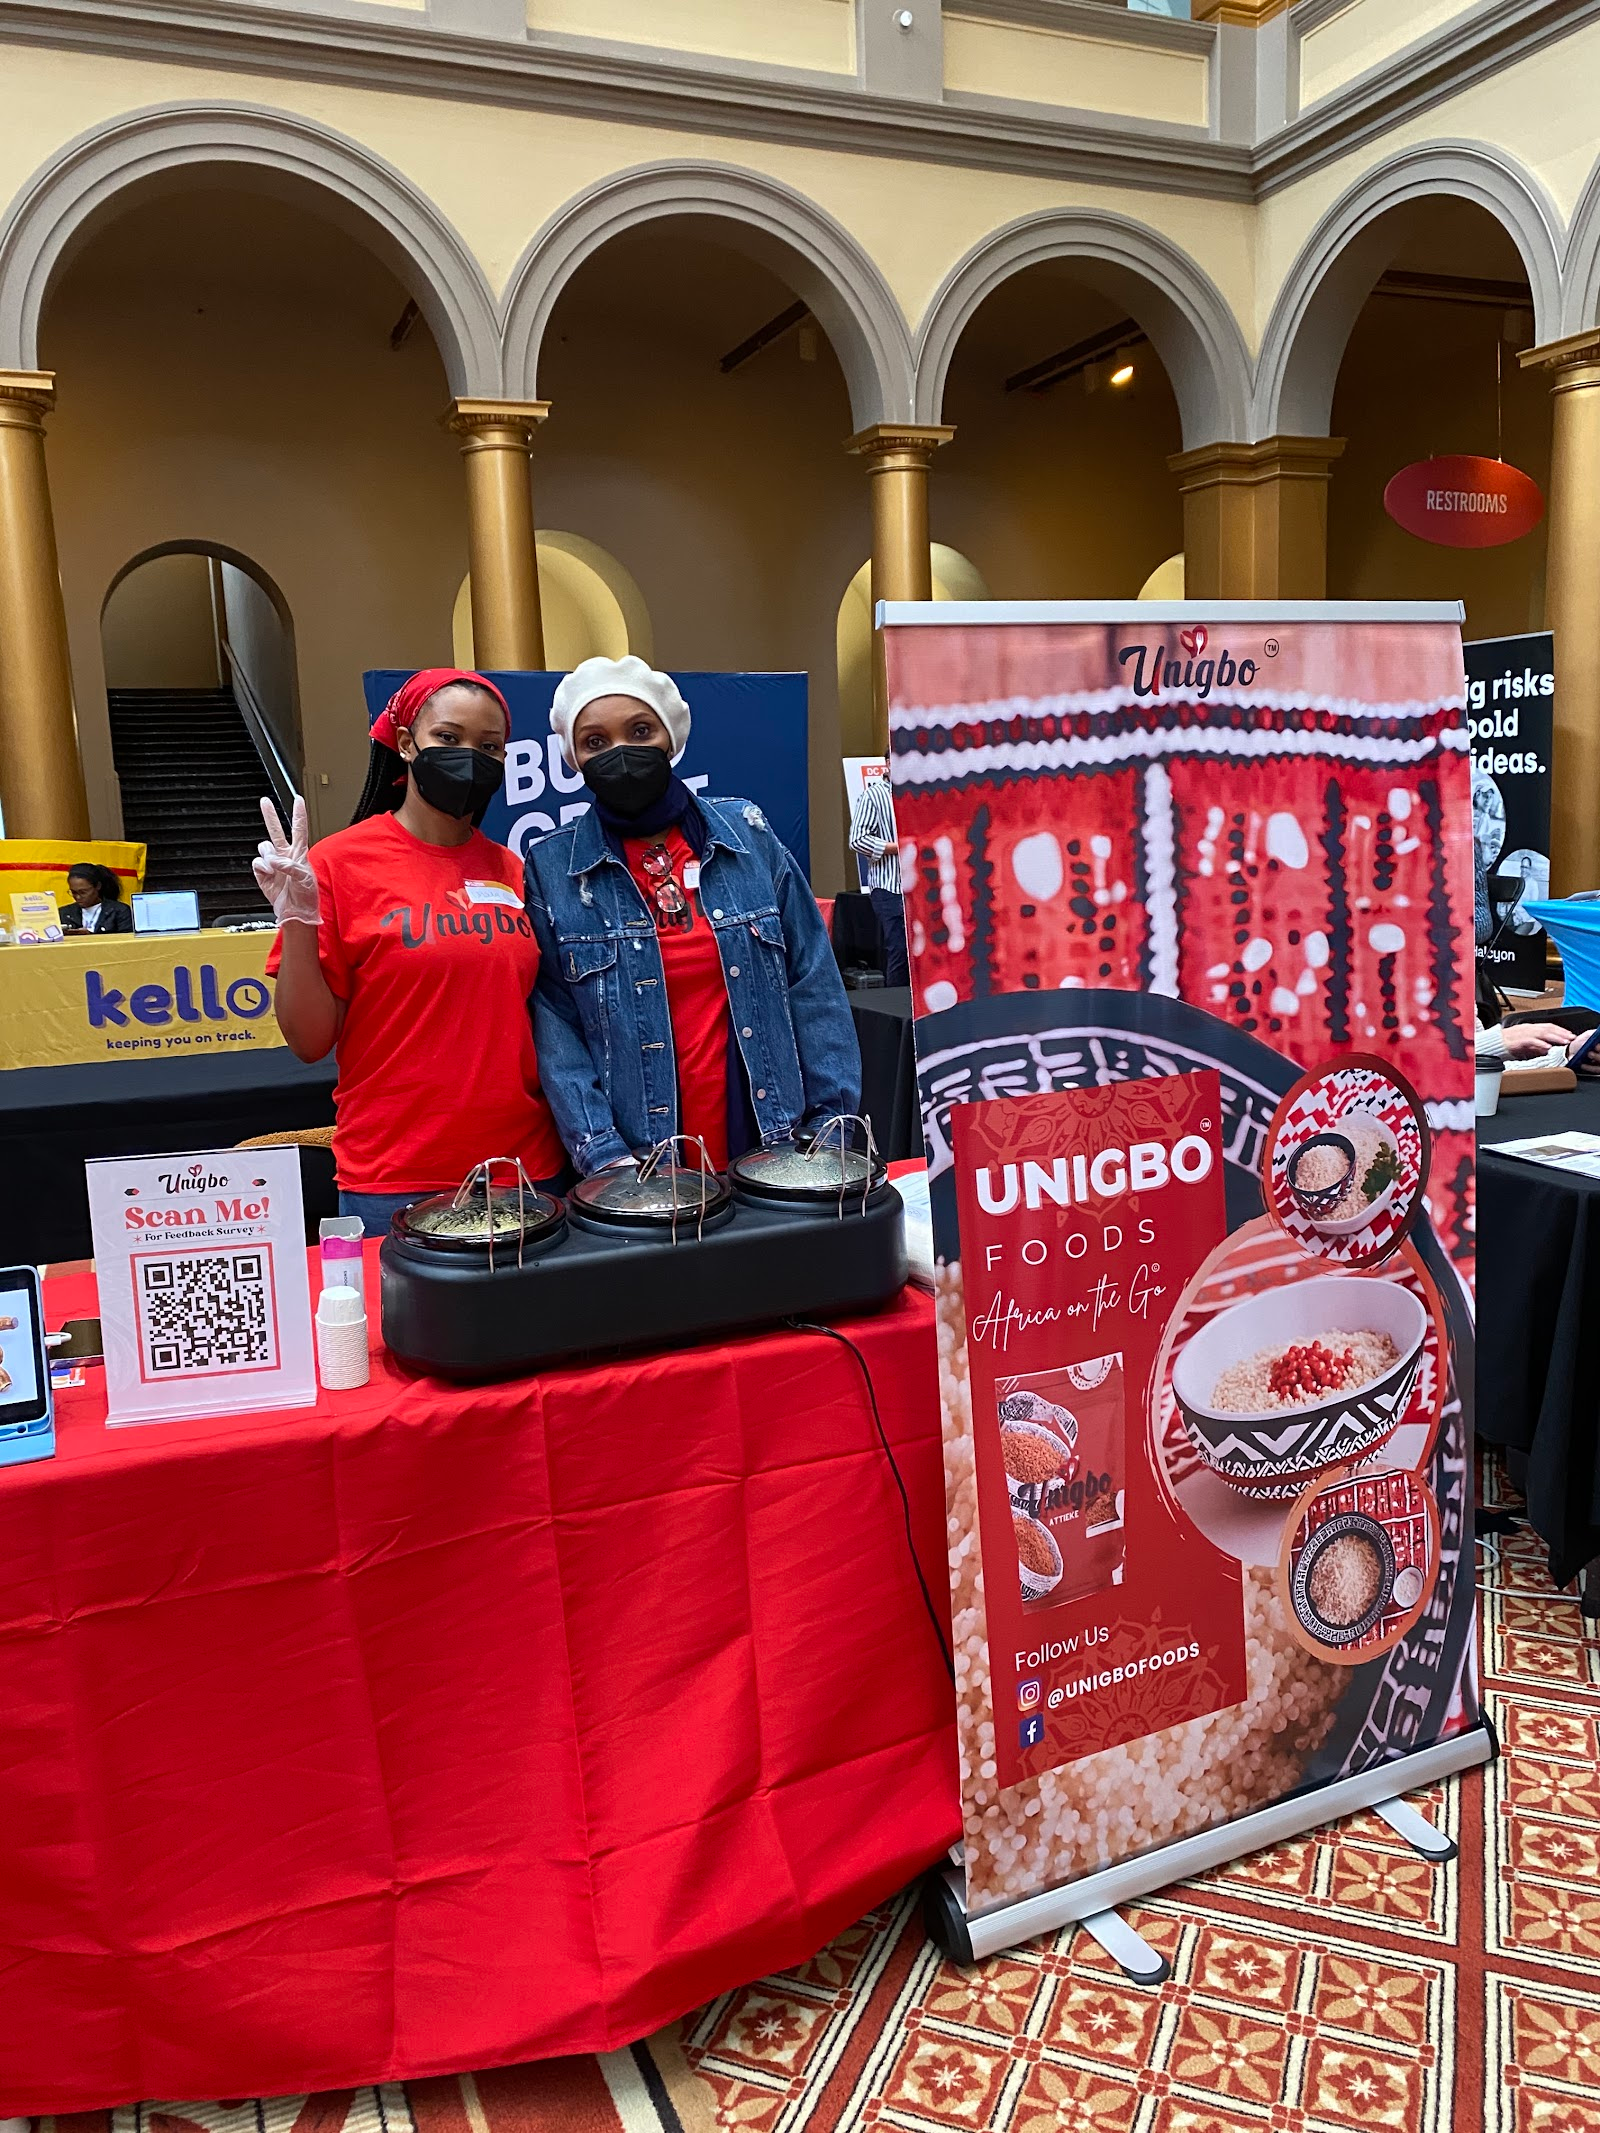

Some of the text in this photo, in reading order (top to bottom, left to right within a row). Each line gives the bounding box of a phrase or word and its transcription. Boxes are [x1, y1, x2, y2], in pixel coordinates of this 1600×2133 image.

[1426, 490, 1508, 513] RESTROOMS
[1118, 645, 1260, 698] Unigbo
[1464, 667, 1555, 710] ig risks
[1470, 746, 1547, 775] ideas.
[380, 903, 531, 948] Unigbo
[85, 964, 273, 1029] kello
[106, 1029, 256, 1051] keeping you on track.
[158, 1173, 231, 1194] Unigbo
[975, 1134, 1213, 1214] UNIGBO
[125, 1197, 270, 1230] Scan Me!
[145, 1225, 255, 1242] For Feedback Survey
[986, 1218, 1156, 1272] FOODS
[973, 1263, 1167, 1351] Africa on the Go
[1018, 1470, 1112, 1518] Unigbo
[1049, 1510, 1080, 1526] ATTIEKE
[1015, 1626, 1109, 1672] Follow Us
[1048, 1642, 1200, 1709] @UNIGBOFOODS
